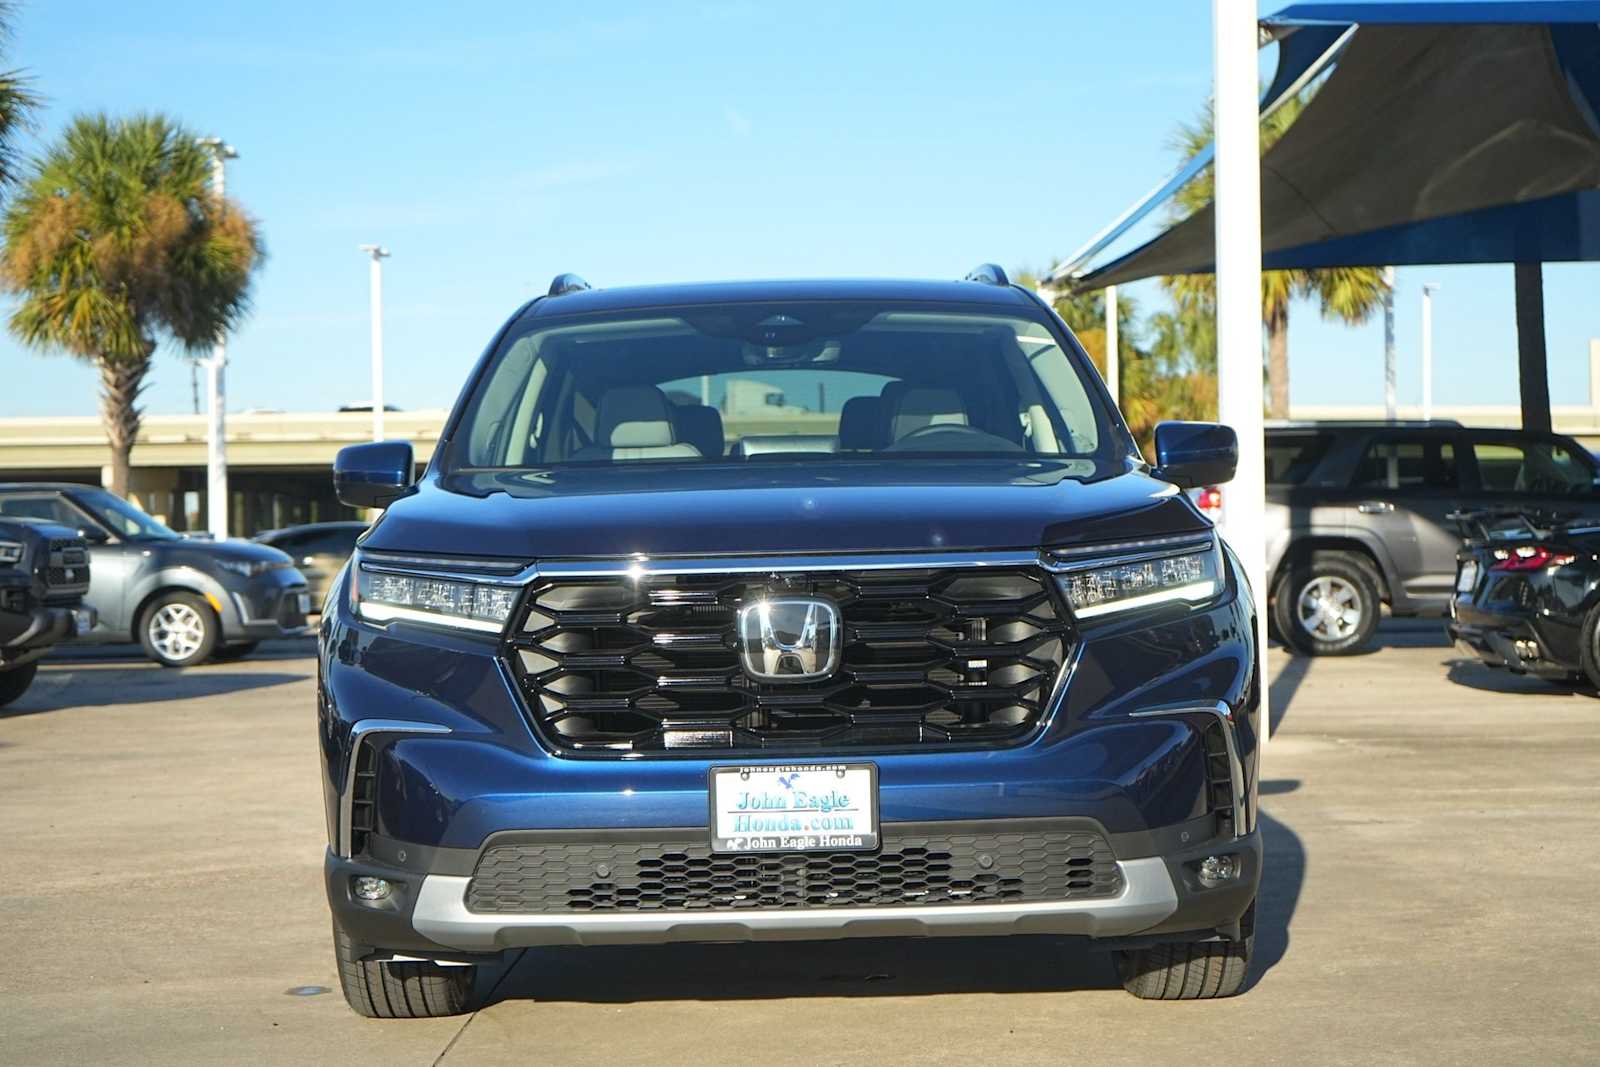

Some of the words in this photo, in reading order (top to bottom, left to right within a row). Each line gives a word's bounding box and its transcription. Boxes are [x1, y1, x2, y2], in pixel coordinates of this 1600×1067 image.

[737, 792, 787, 810] John
[793, 790, 850, 812] Eagle
[734, 815, 854, 833] Honda.com
[744, 838, 777, 850] John
[780, 836, 816, 849] Eagle
[819, 835, 862, 847] Honda
